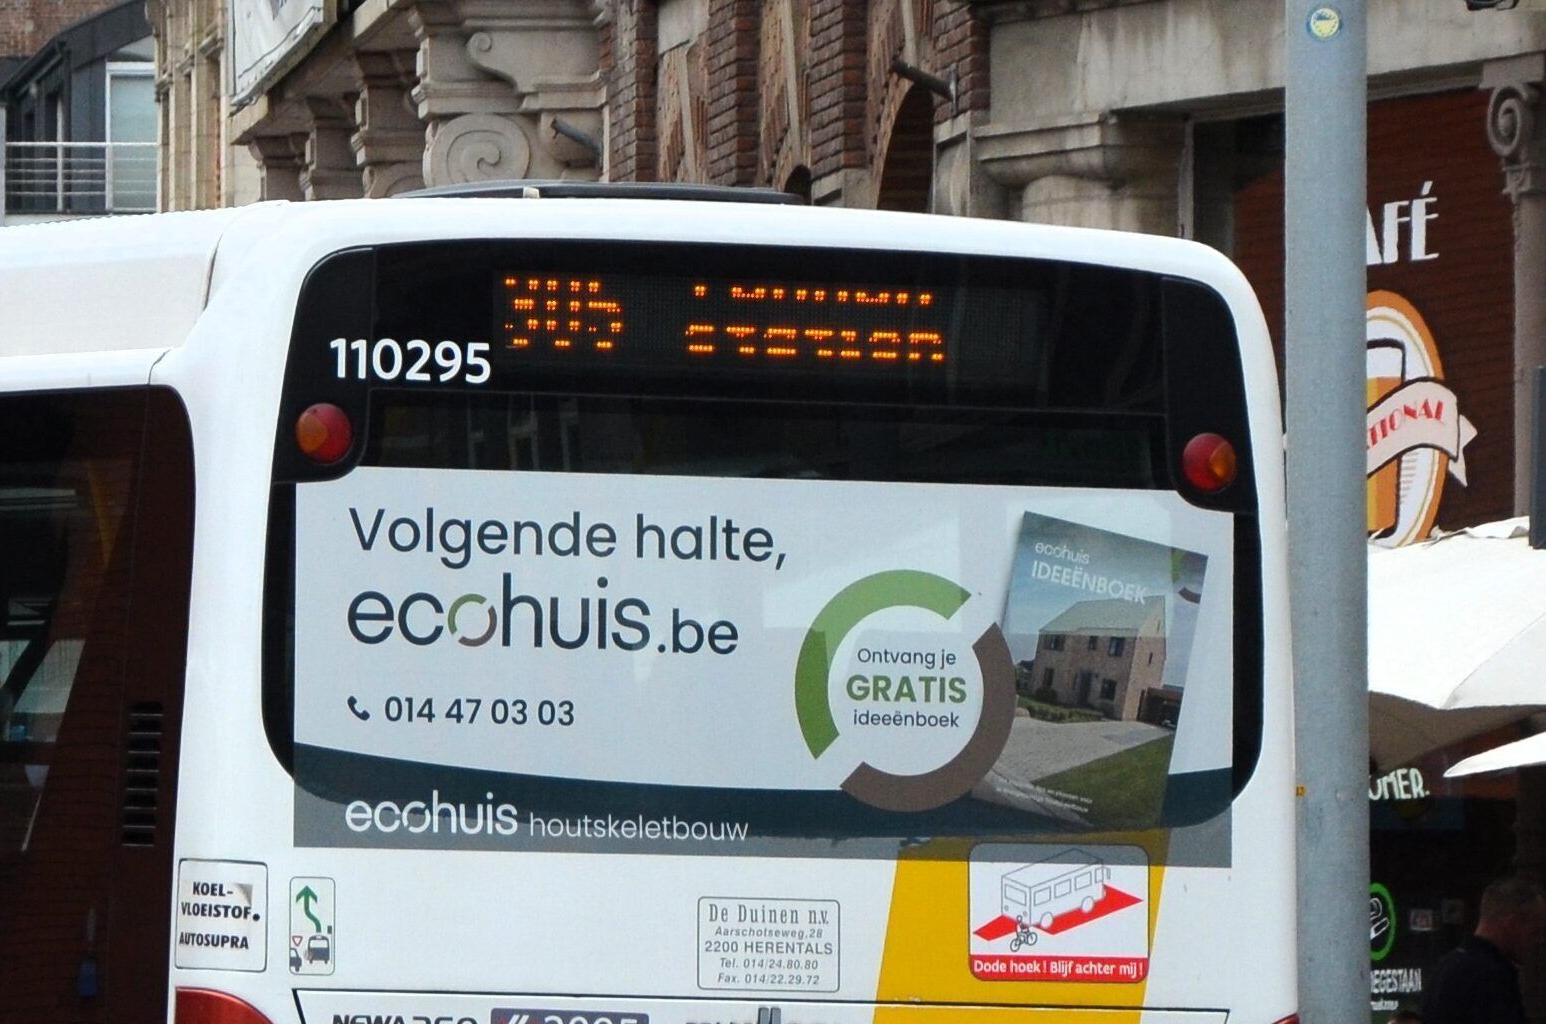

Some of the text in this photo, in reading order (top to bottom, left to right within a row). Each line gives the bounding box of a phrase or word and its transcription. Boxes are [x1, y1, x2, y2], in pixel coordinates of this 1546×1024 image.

[330, 337, 492, 383] 110295
[349, 507, 787, 570] Volgende halte,
[1034, 542, 1091, 565] ecohuis
[1031, 560, 1148, 604] IDEEËNBOEK
[347, 572, 739, 654] ecohuis.be
[857, 648, 957, 670] Ontvang je
[846, 674, 967, 703] GRATIS
[384, 696, 575, 726] 014 47 03 03
[853, 709, 960, 727] ideeënboek
[345, 790, 749, 841] ecohuis houtskeletbouw
[192, 881, 234, 897] KOEL-
[709, 903, 829, 925] De Duinen n.v.
[179, 931, 249, 950] AUTOSUPRA
[705, 941, 833, 955] 2200 HERENTALS
[720, 957, 819, 970] Tel. 014/24.80.80
[973, 960, 1007, 973] Dode
[1050, 960, 1073, 977] Blijf
[1075, 963, 1115, 975] achter
[718, 973, 820, 985] Fax. 014/22.29.72
